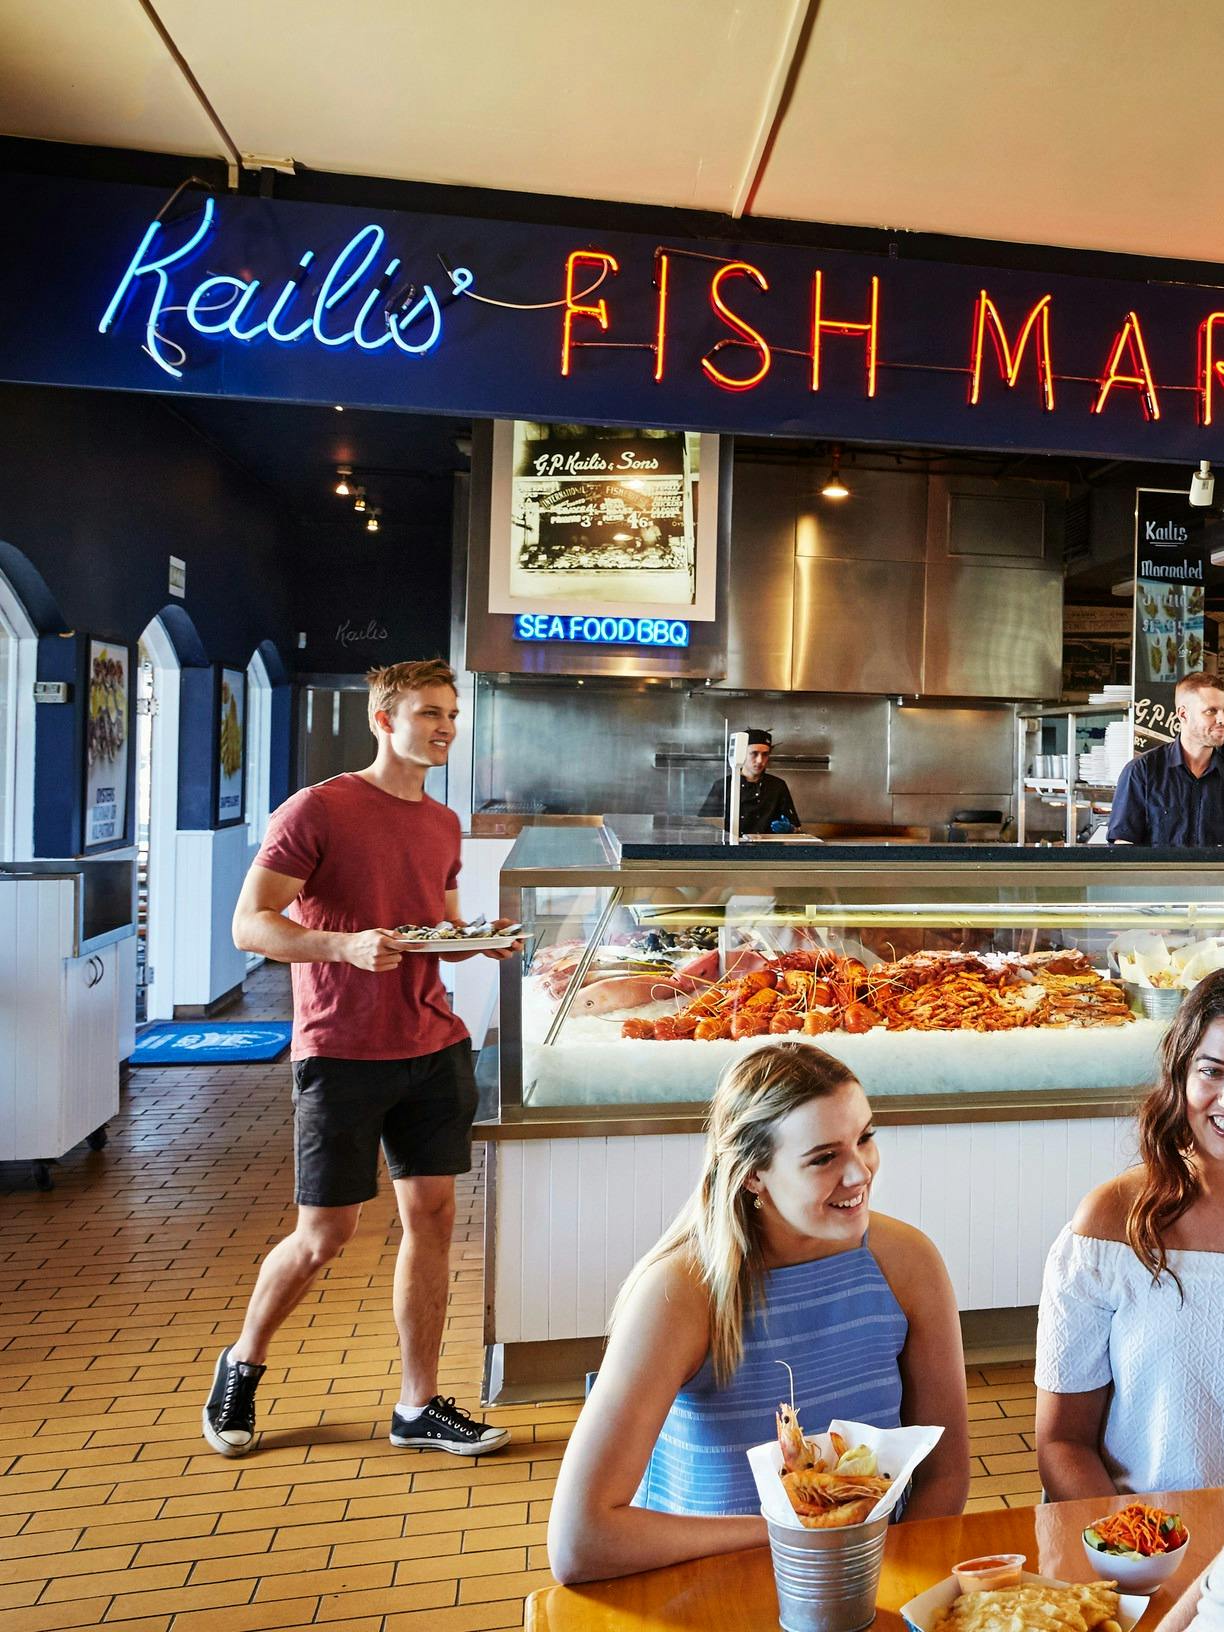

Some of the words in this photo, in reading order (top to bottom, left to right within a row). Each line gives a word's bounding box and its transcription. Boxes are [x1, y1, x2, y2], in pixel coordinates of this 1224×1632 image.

[561, 250, 879, 398] FISH
[617, 451, 659, 471] Sons
[1145, 521, 1188, 542] Kailis
[335, 619, 389, 648] Kailis
[520, 614, 564, 640] SEA
[571, 617, 635, 641] FOOD
[637, 621, 687, 646] BBQ
